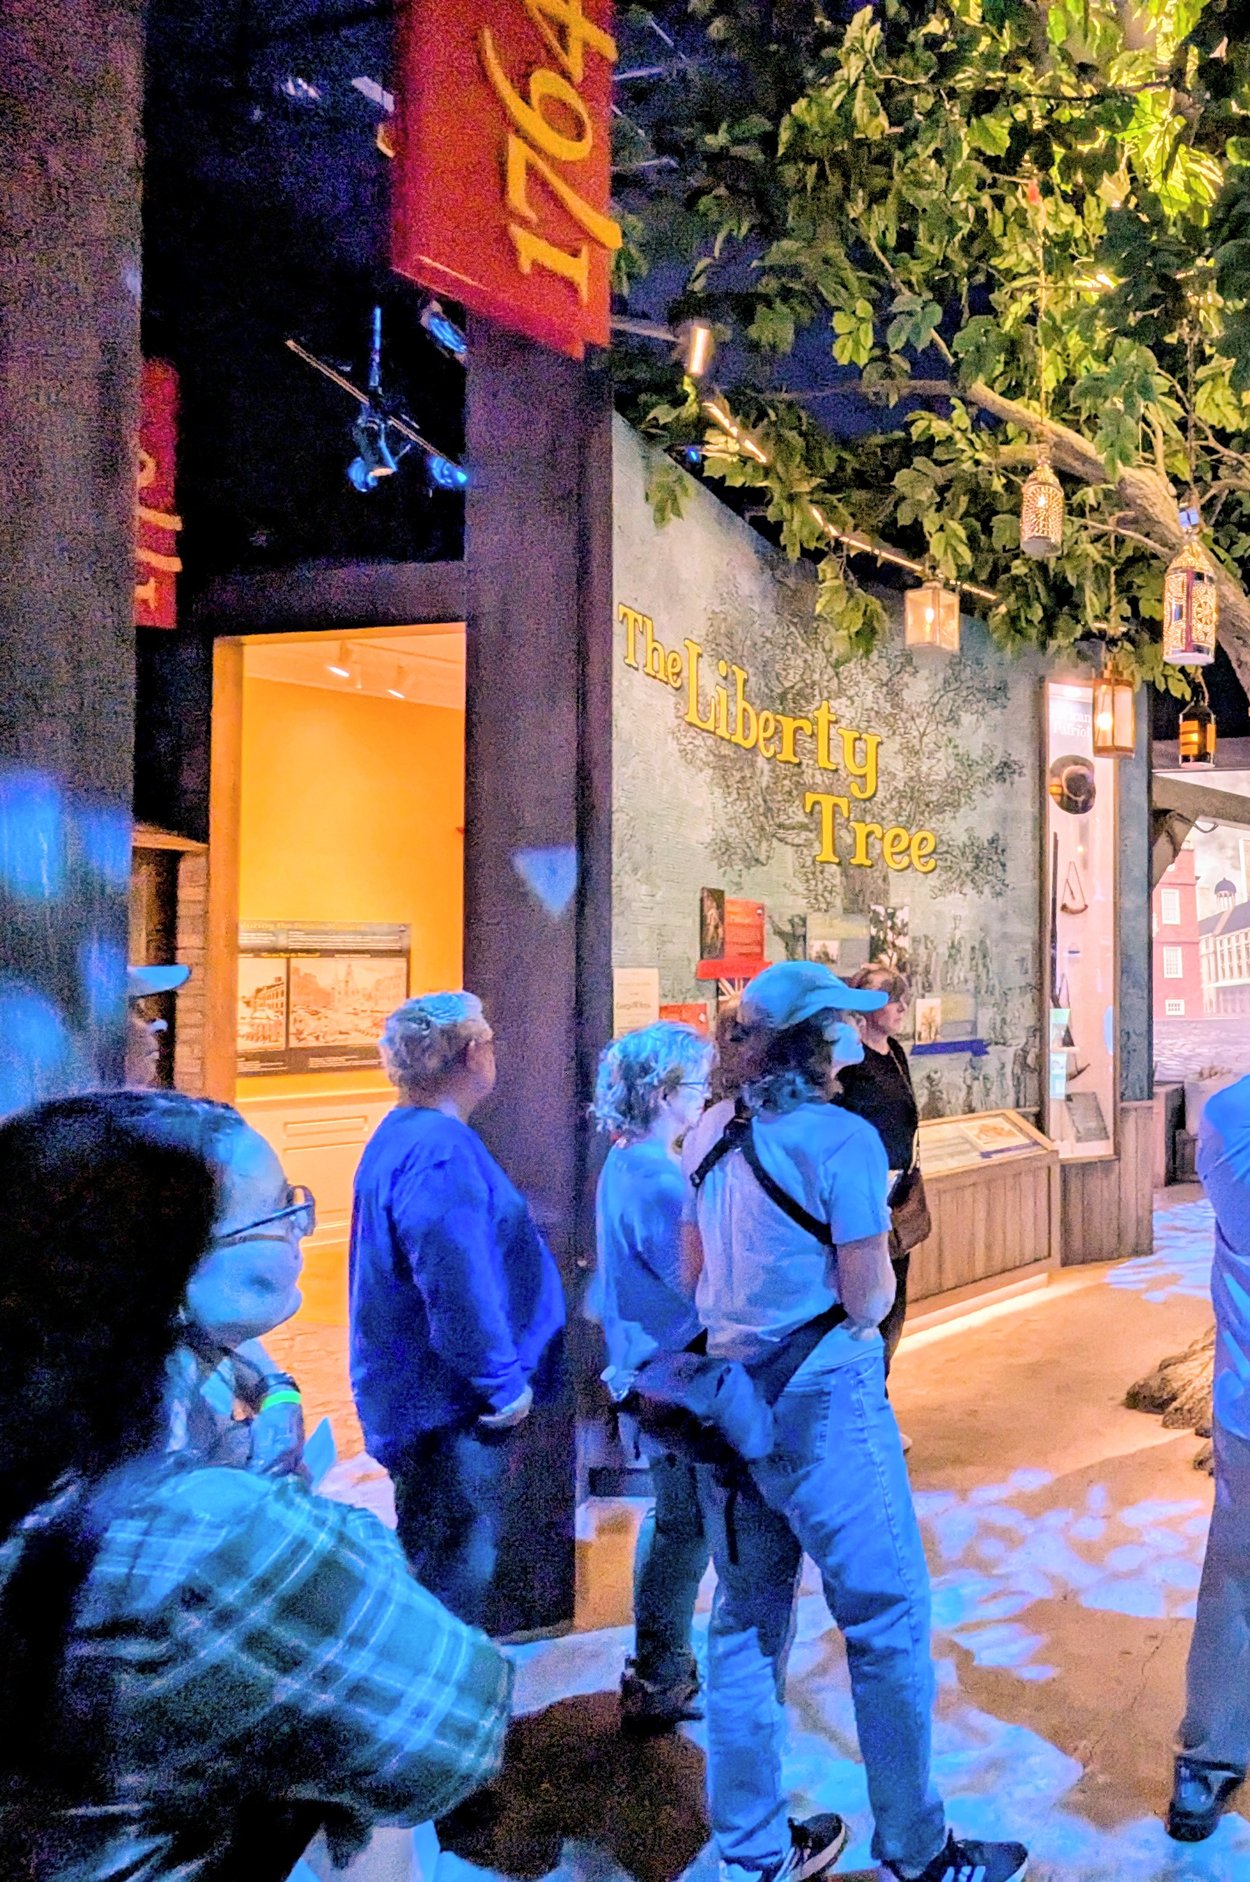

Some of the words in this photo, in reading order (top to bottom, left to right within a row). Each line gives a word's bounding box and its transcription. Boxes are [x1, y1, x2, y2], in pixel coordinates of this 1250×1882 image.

[480, 0, 624, 304] 1764
[618, 602, 683, 690] The
[683, 637, 883, 800] Liberty
[804, 791, 937, 873] Tree
